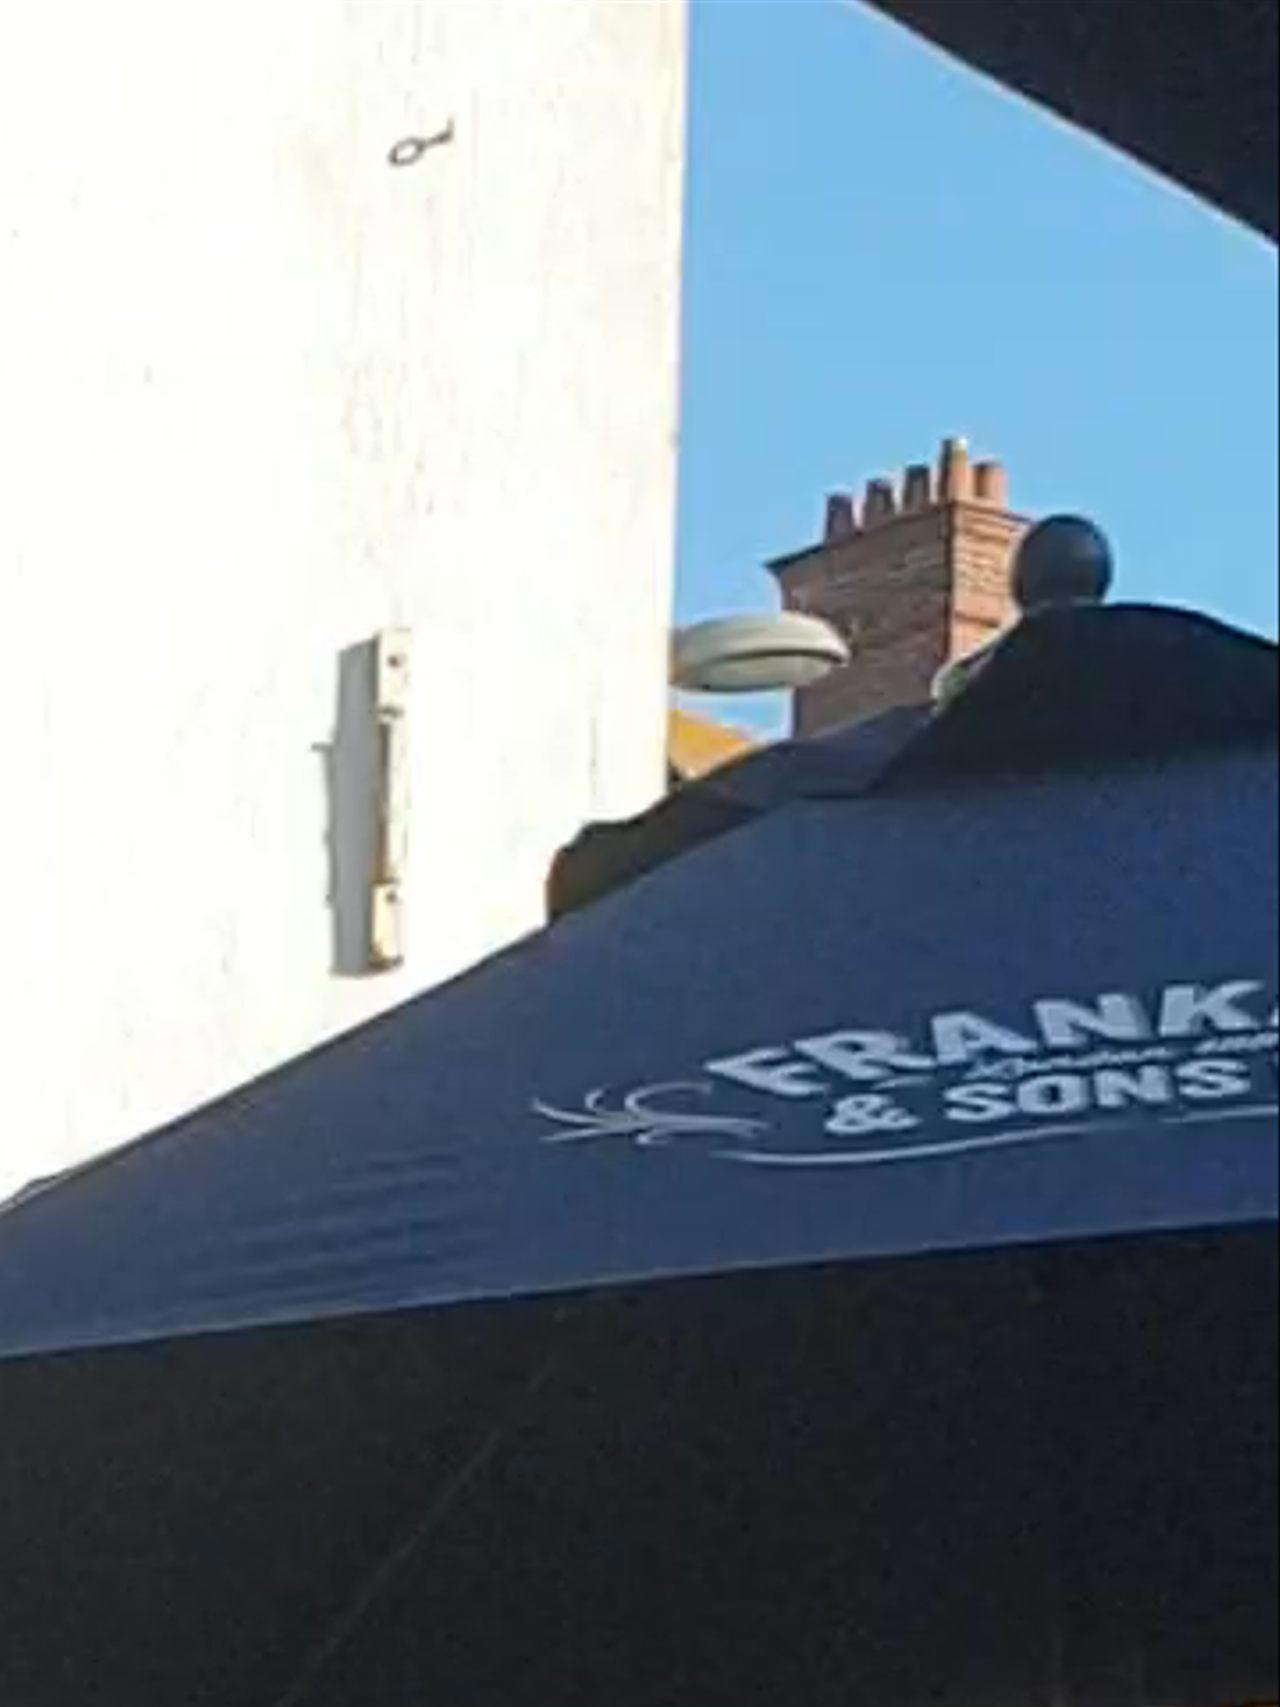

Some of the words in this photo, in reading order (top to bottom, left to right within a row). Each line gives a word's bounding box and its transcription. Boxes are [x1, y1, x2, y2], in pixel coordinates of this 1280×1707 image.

[706, 979, 1280, 1096] FRANK
[824, 1092, 920, 1136] &
[944, 1057, 1252, 1122] SONS
